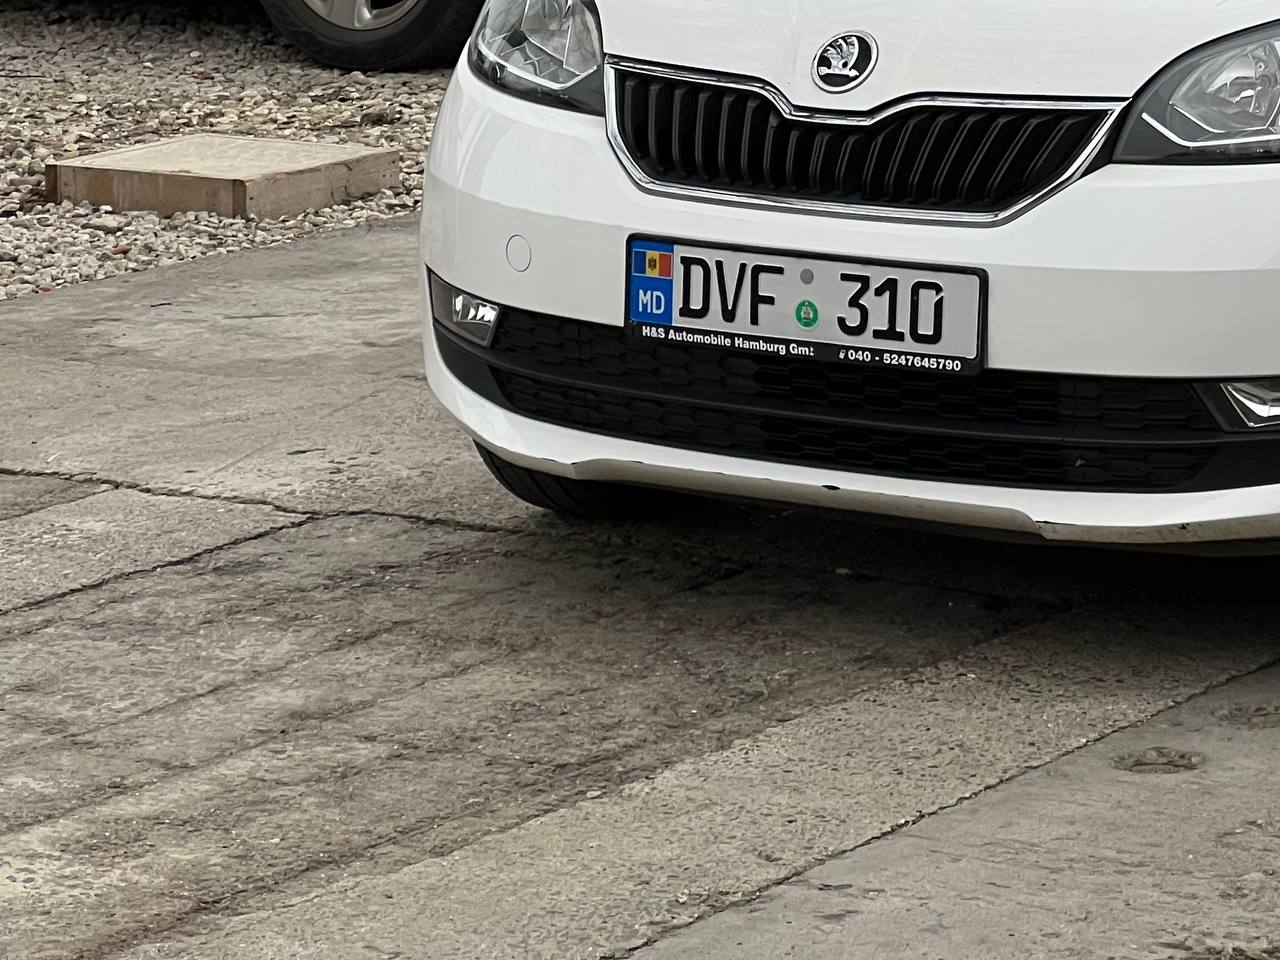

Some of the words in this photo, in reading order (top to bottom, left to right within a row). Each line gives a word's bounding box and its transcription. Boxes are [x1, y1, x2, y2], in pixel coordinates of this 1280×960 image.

[638, 290, 665, 315] MD
[678, 255, 785, 326] DVF
[836, 272, 944, 345] 310
[642, 325, 665, 339] H&S
[668, 329, 732, 347] Automobile
[734, 336, 786, 355] Hamburg
[847, 349, 871, 362] 040
[883, 353, 962, 371] 5247645790
